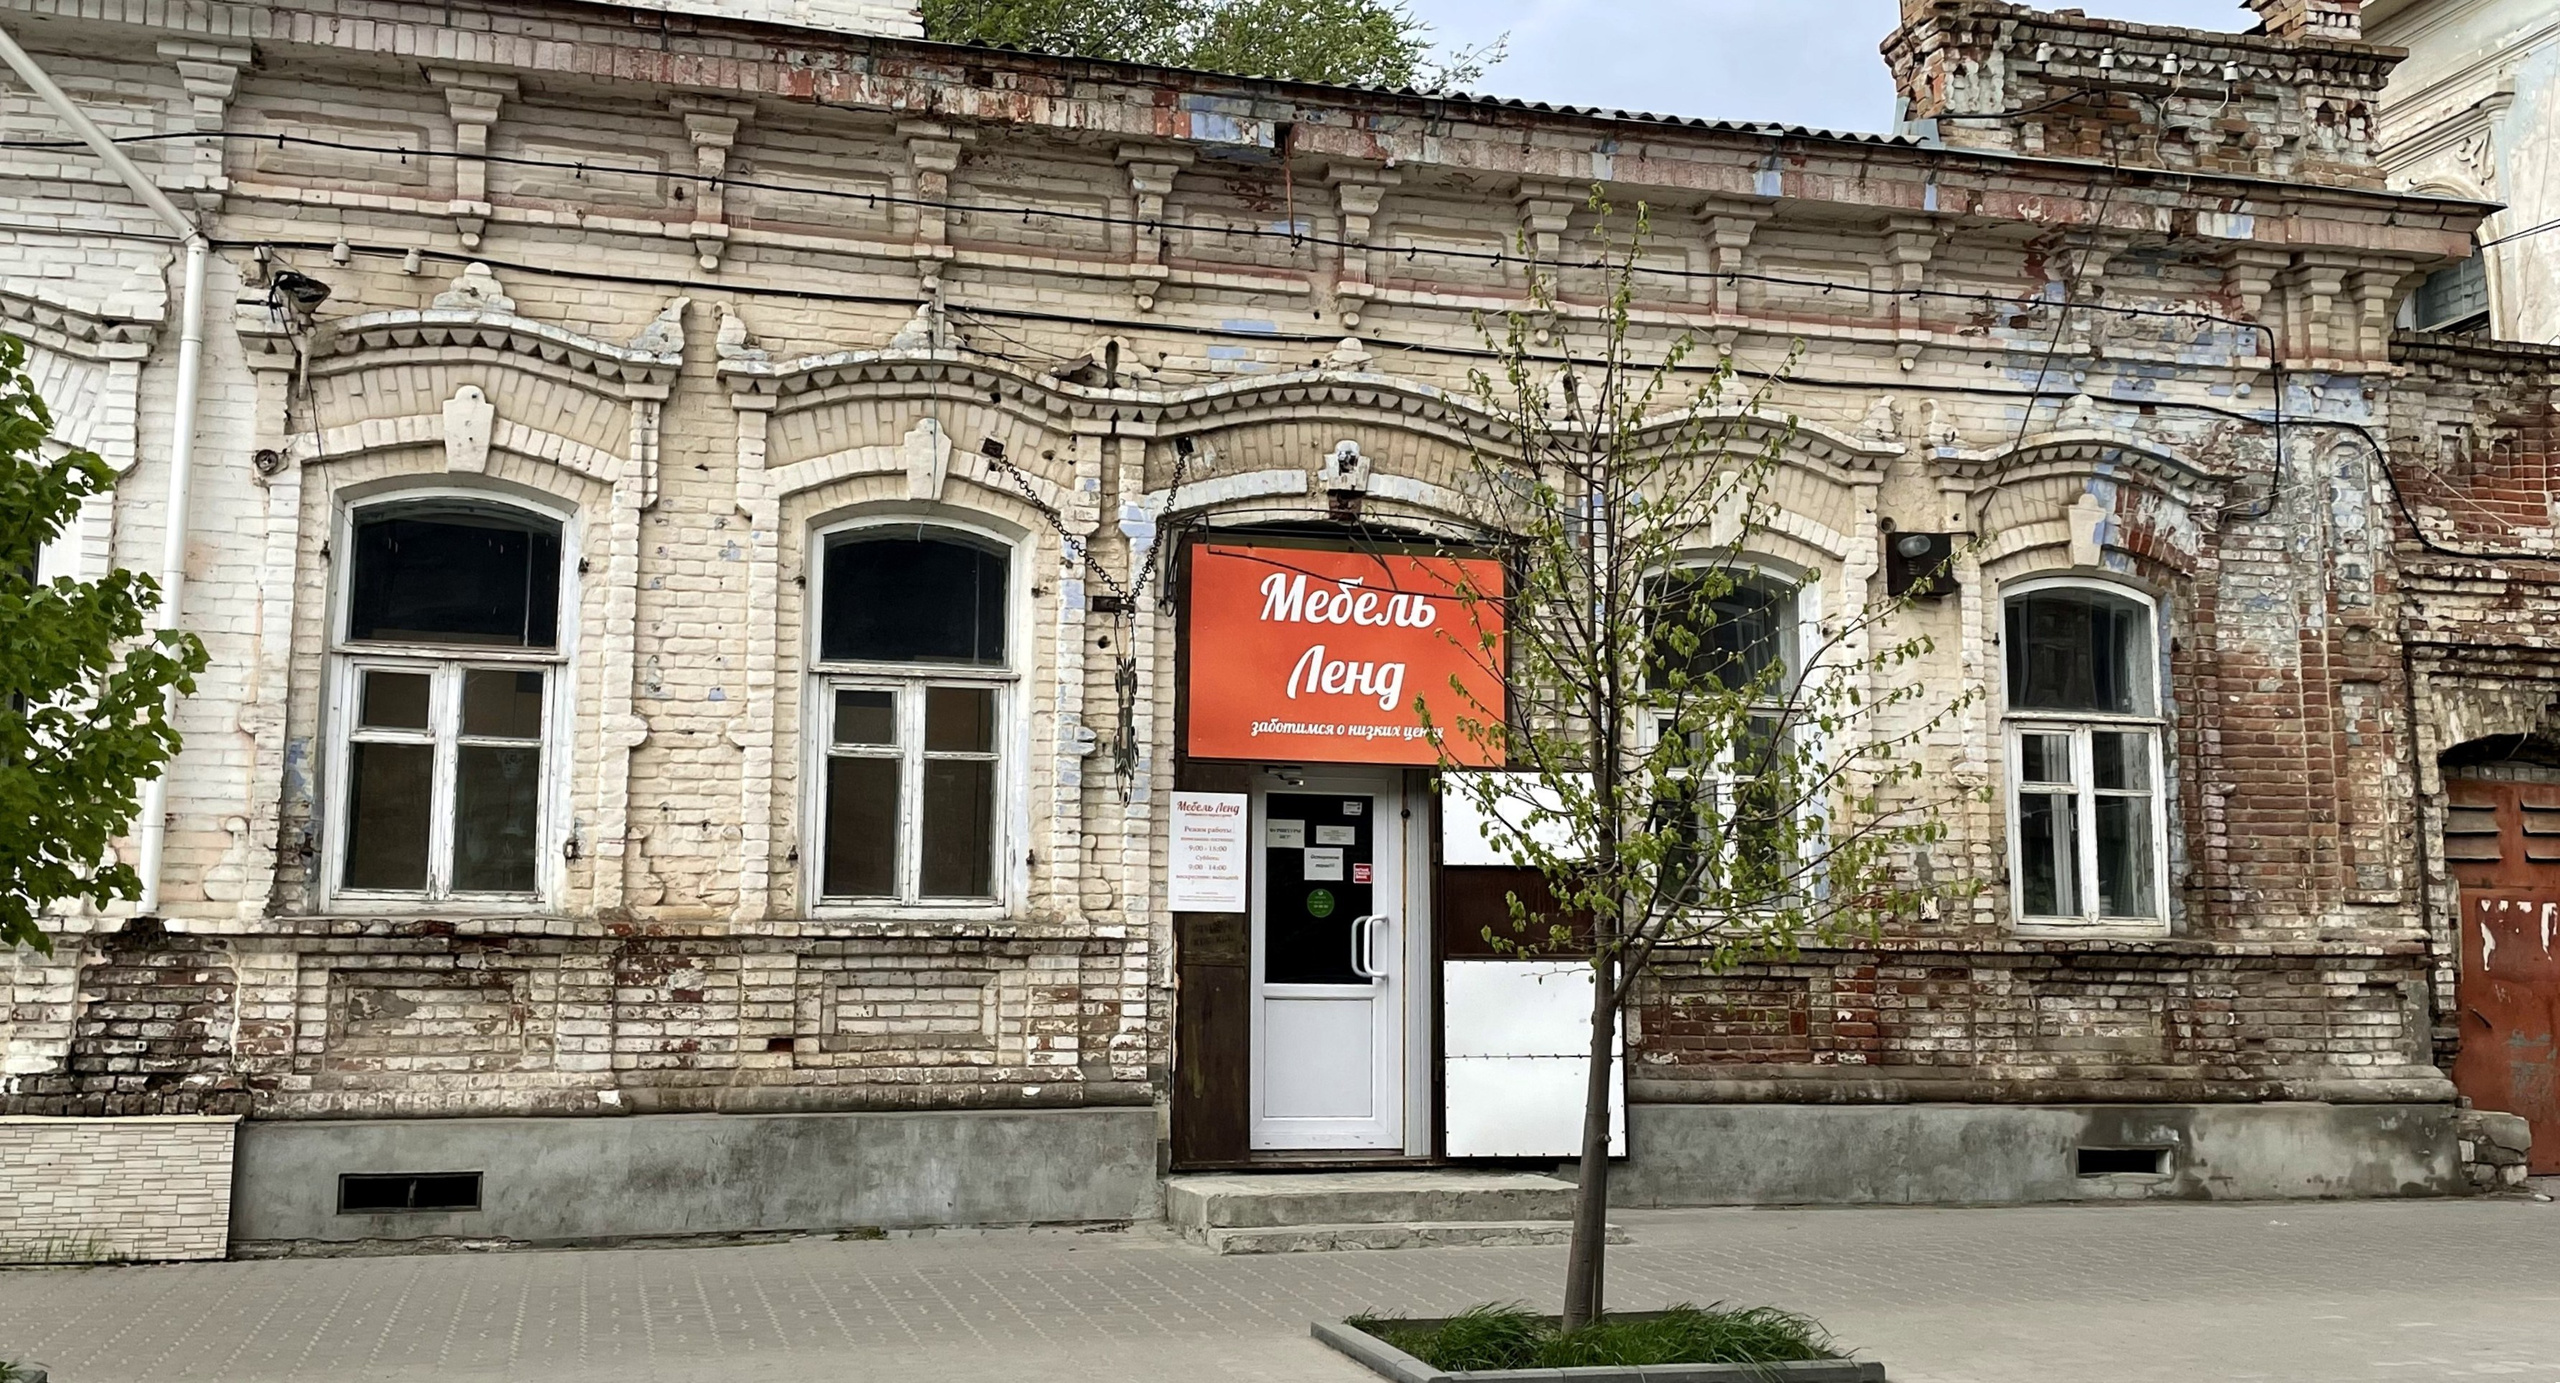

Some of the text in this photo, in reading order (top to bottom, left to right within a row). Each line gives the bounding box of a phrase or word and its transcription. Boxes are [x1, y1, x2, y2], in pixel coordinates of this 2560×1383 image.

[1260, 572, 1437, 628] Мебель
[1286, 644, 1406, 711] Ленд
[1251, 718, 1334, 736] заботимся
[1336, 724, 1345, 735] о
[1348, 724, 1400, 740] низких
[1177, 801, 1213, 812] Мебель
[1216, 802, 1240, 815] Ленд
